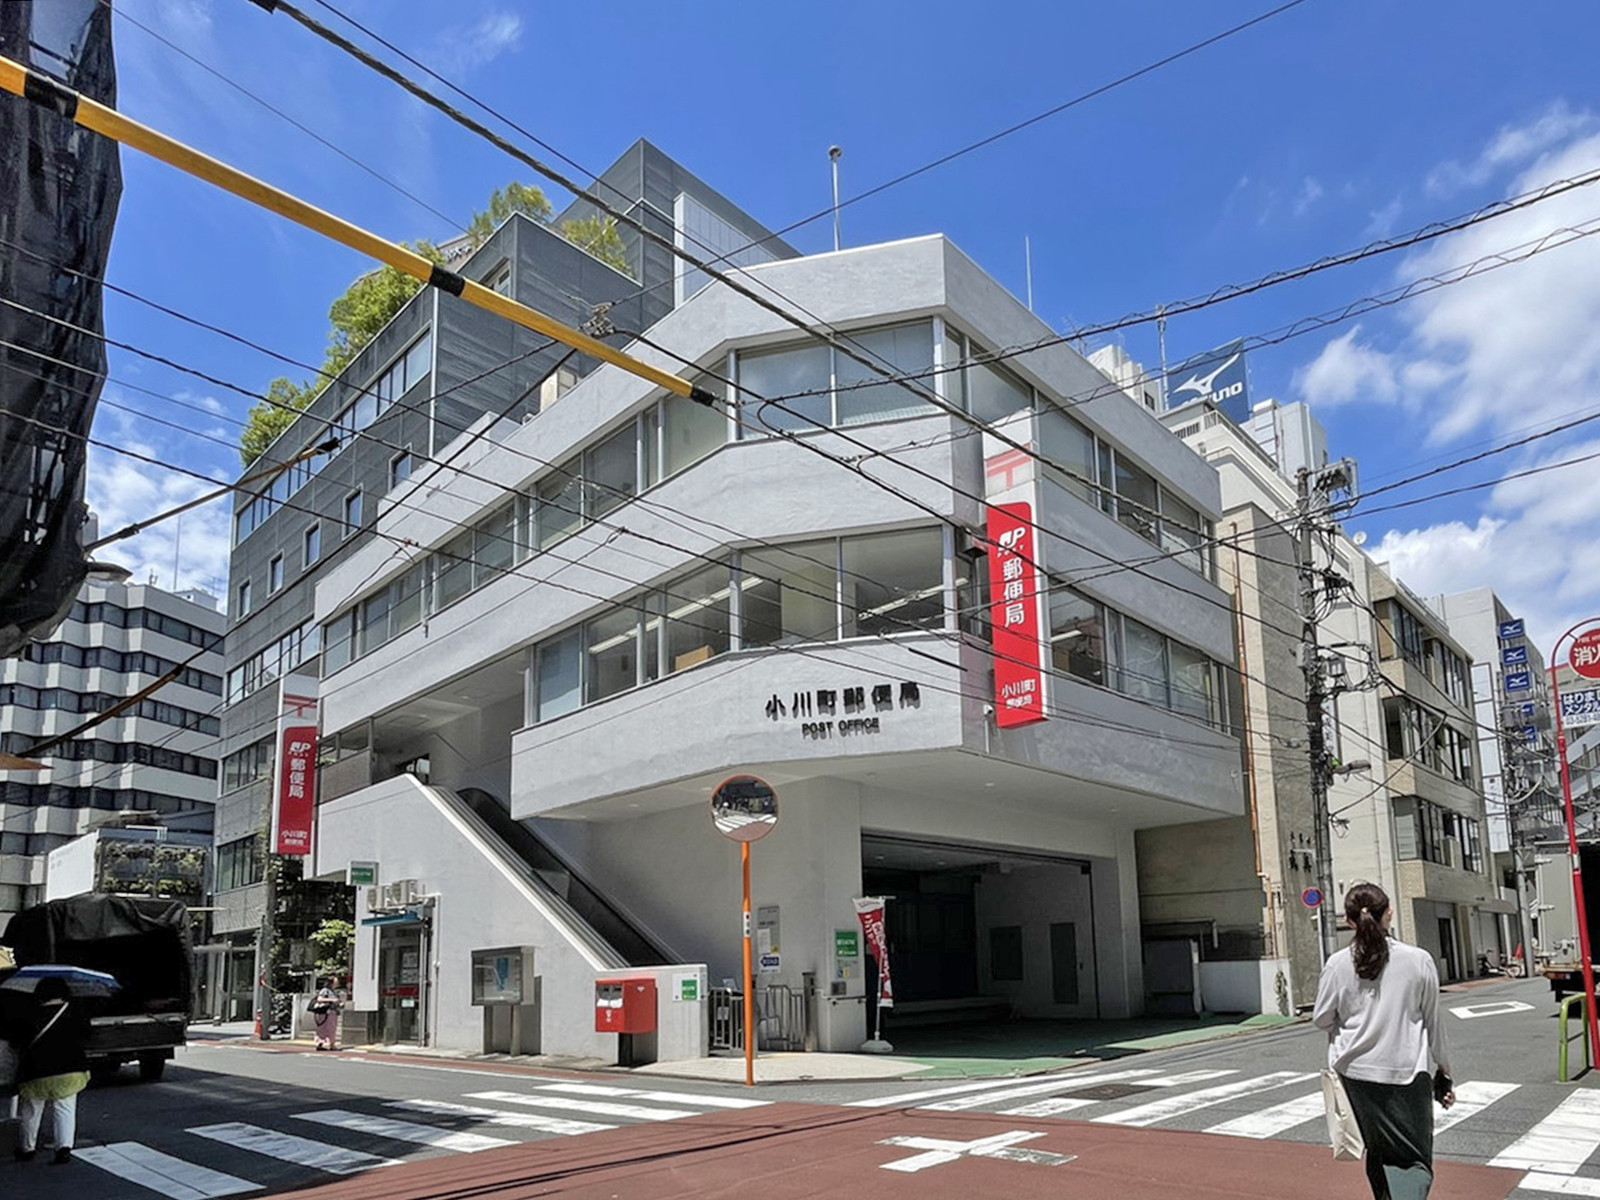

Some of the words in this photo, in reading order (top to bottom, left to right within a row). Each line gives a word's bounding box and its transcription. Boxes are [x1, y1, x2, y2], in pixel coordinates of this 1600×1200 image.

[1003, 557, 1025, 628] 郵便局
[765, 681, 921, 716] 小川町郵便局
[1001, 678, 1035, 699] 小川町
[801, 720, 833, 735] POST
[838, 716, 880, 733] OFFICE
[287, 758, 306, 798] 郵便局
